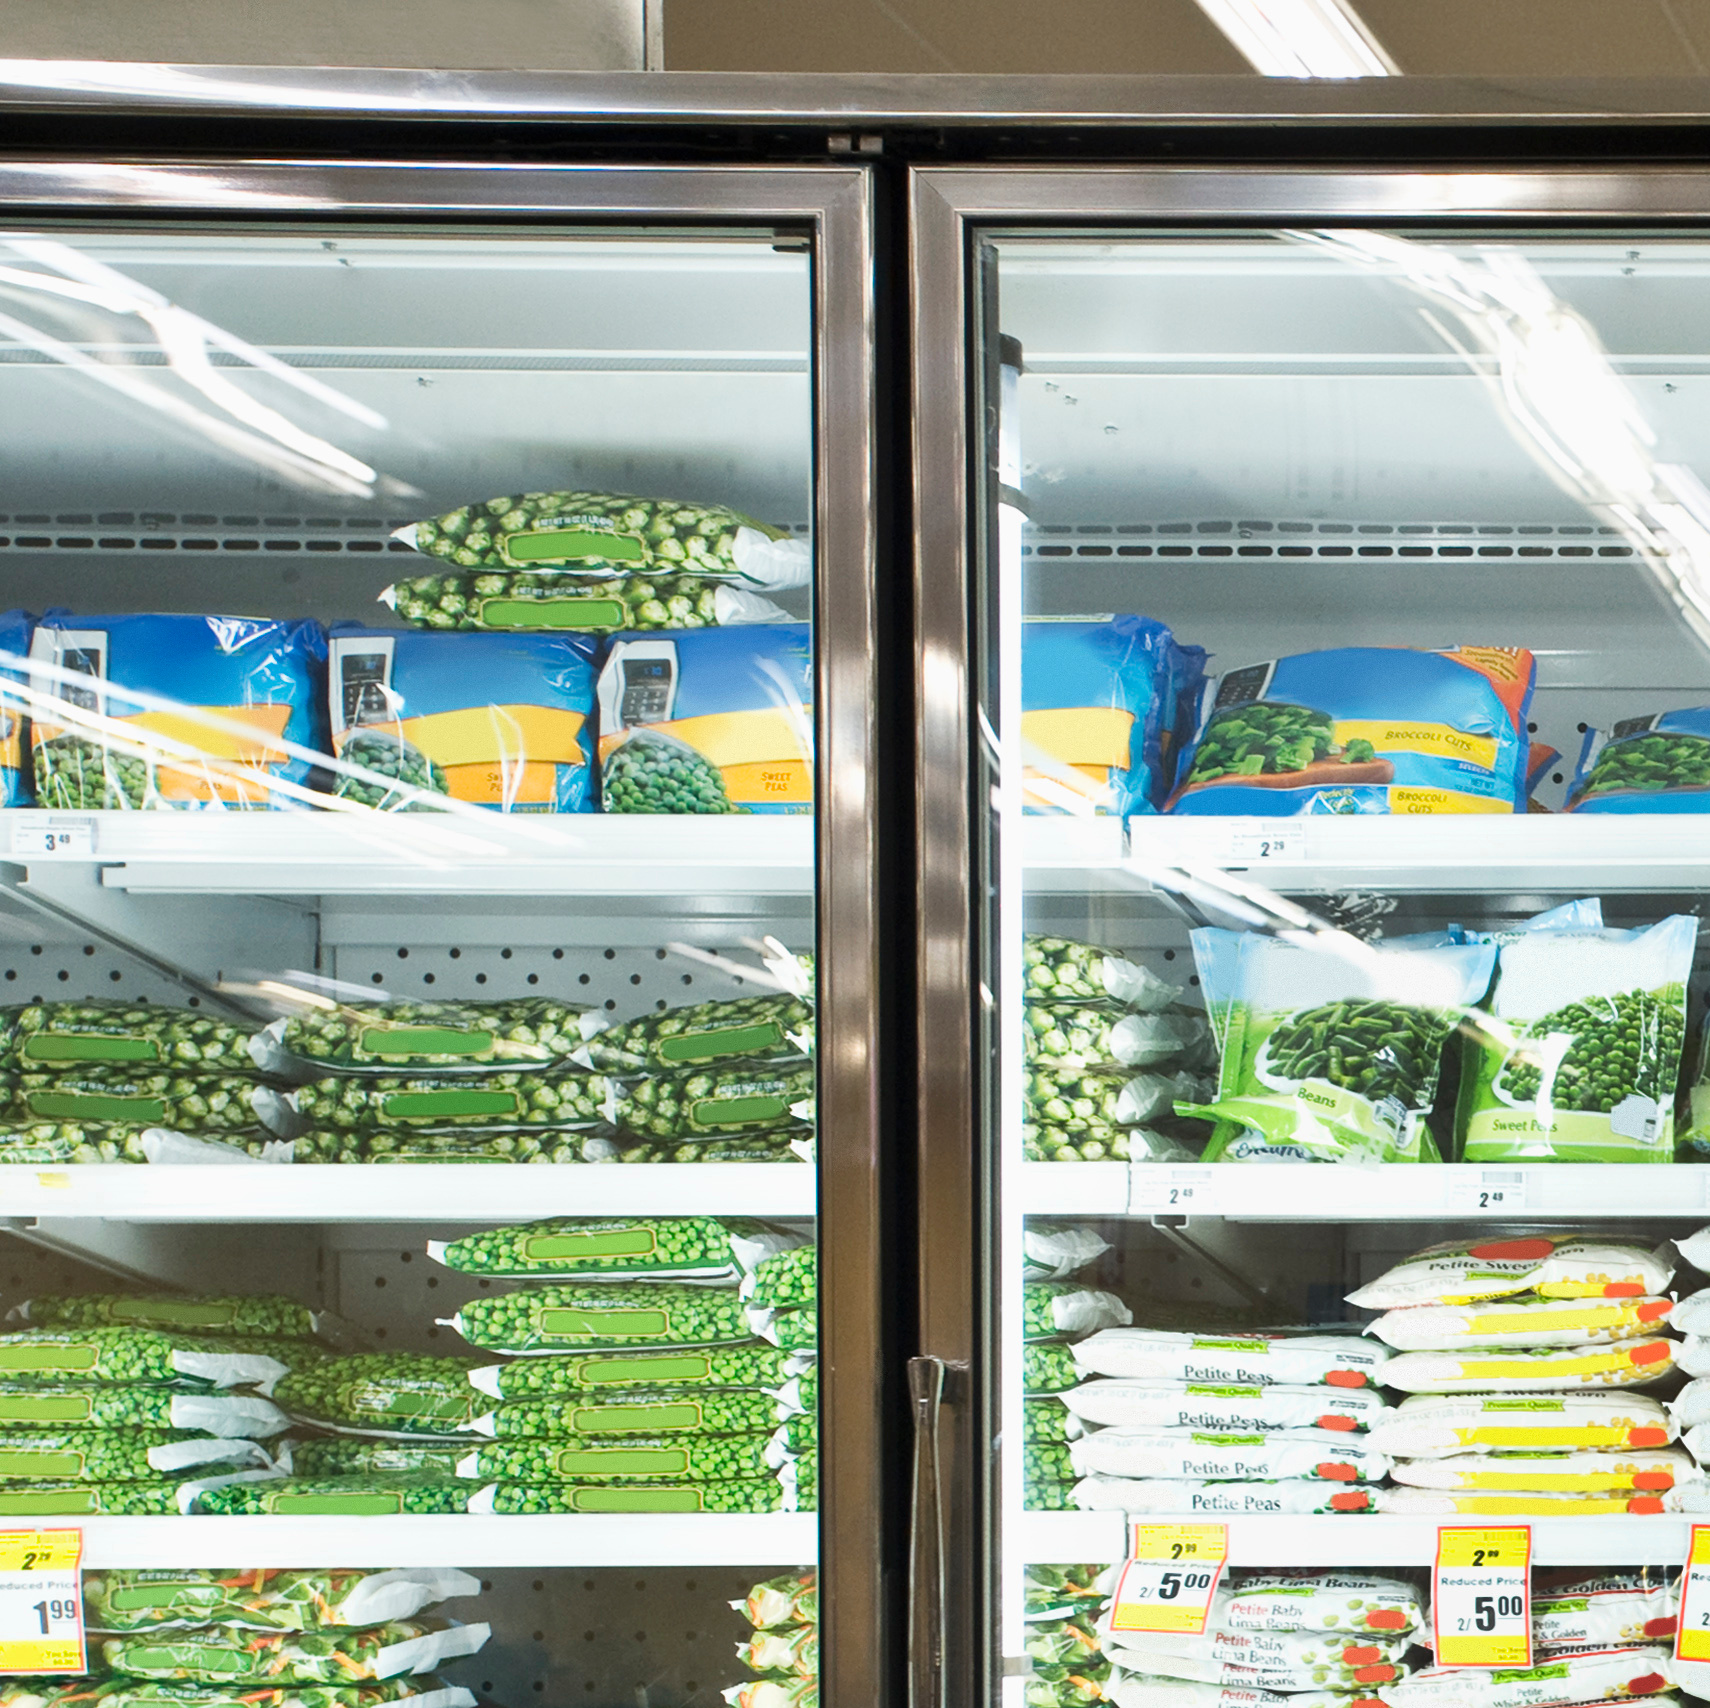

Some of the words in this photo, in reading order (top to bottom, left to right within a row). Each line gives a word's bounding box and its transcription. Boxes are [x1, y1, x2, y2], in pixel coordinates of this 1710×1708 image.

[1444, 738, 1472, 752] CUTS
[760, 771, 791, 781] SWEET
[765, 781, 789, 791] PEAS
[1298, 1088, 1336, 1108] Beans
[1492, 1119, 1527, 1132] Sweet
[1184, 1365, 1230, 1379] Petite
[1237, 1368, 1273, 1383] Peas
[1192, 1495, 1239, 1510] Petite
[1245, 1496, 1281, 1511] Peas
[45, 1580, 78, 1590] Price
